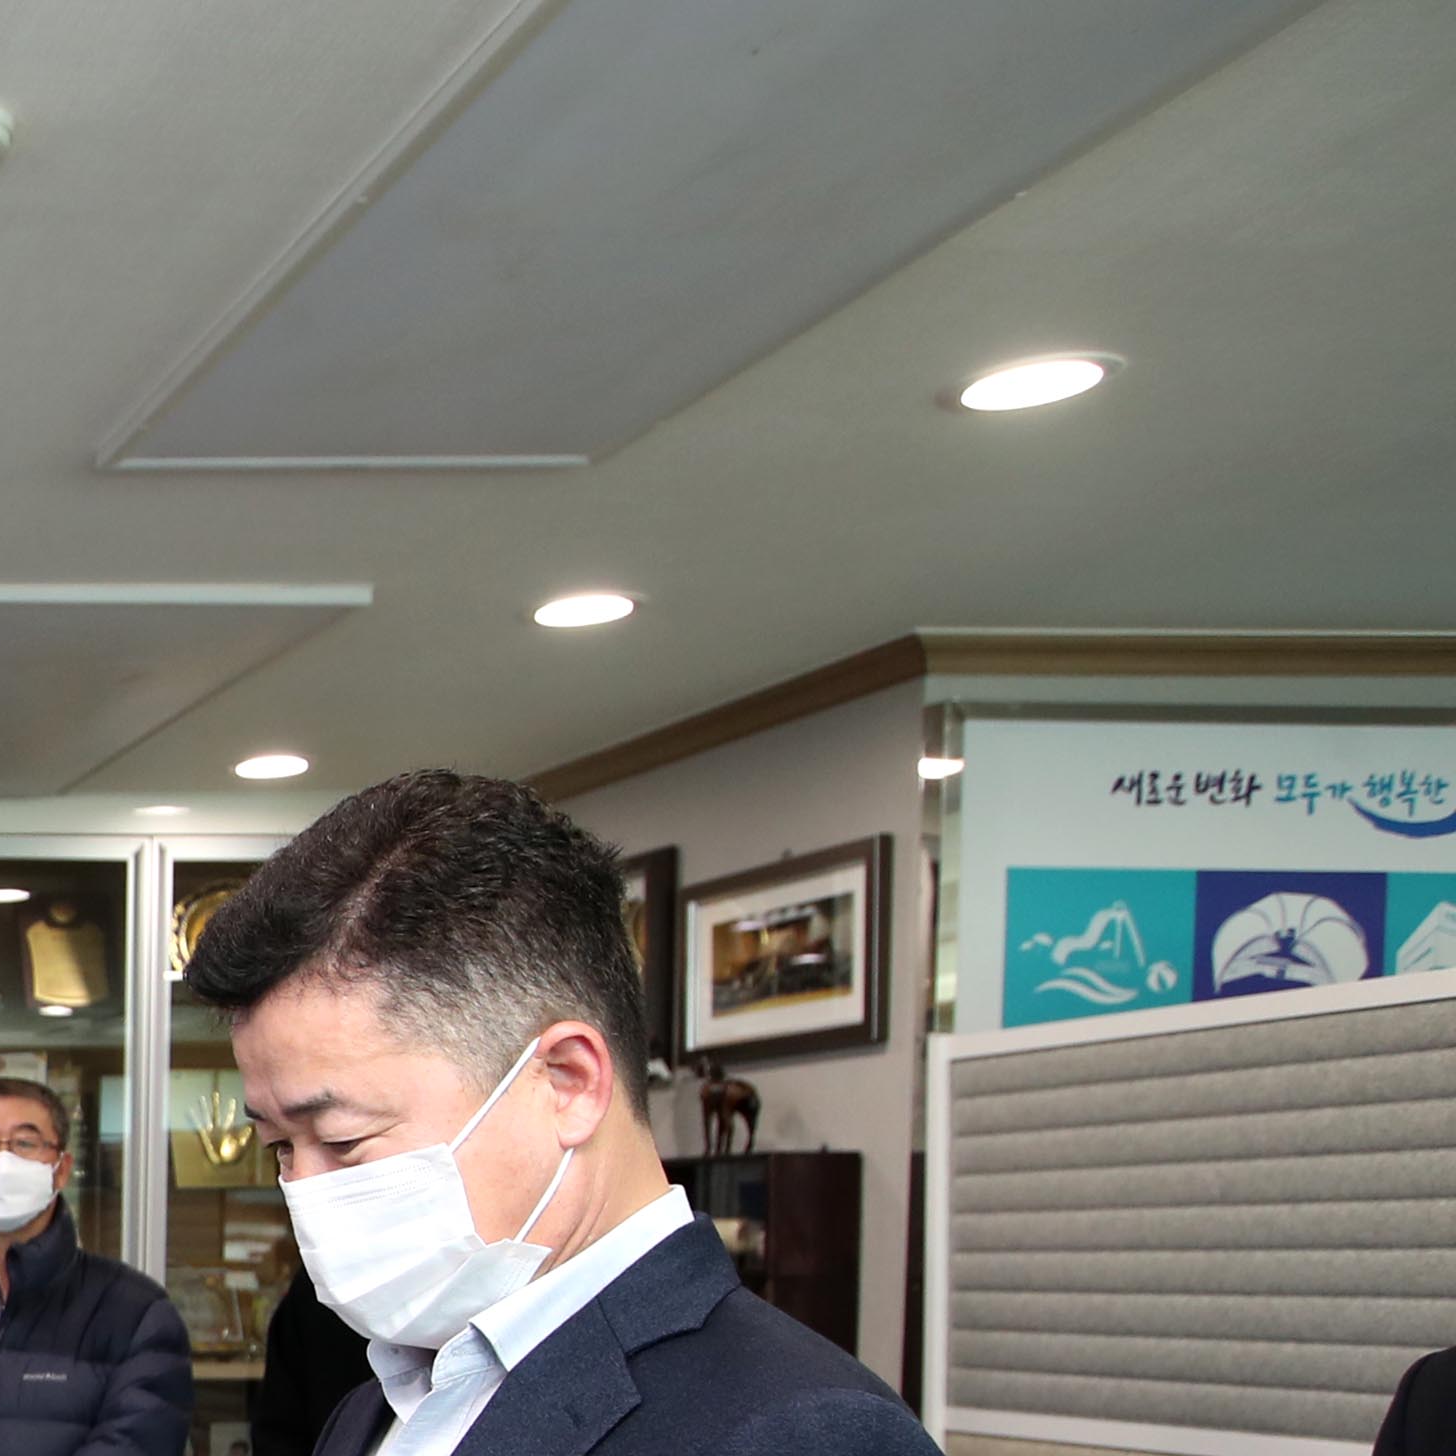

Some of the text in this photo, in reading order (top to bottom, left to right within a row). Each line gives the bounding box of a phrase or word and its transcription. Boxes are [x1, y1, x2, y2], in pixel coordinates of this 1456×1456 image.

[1110, 768, 1449, 817] 새로운 변화 모두가 행복한
